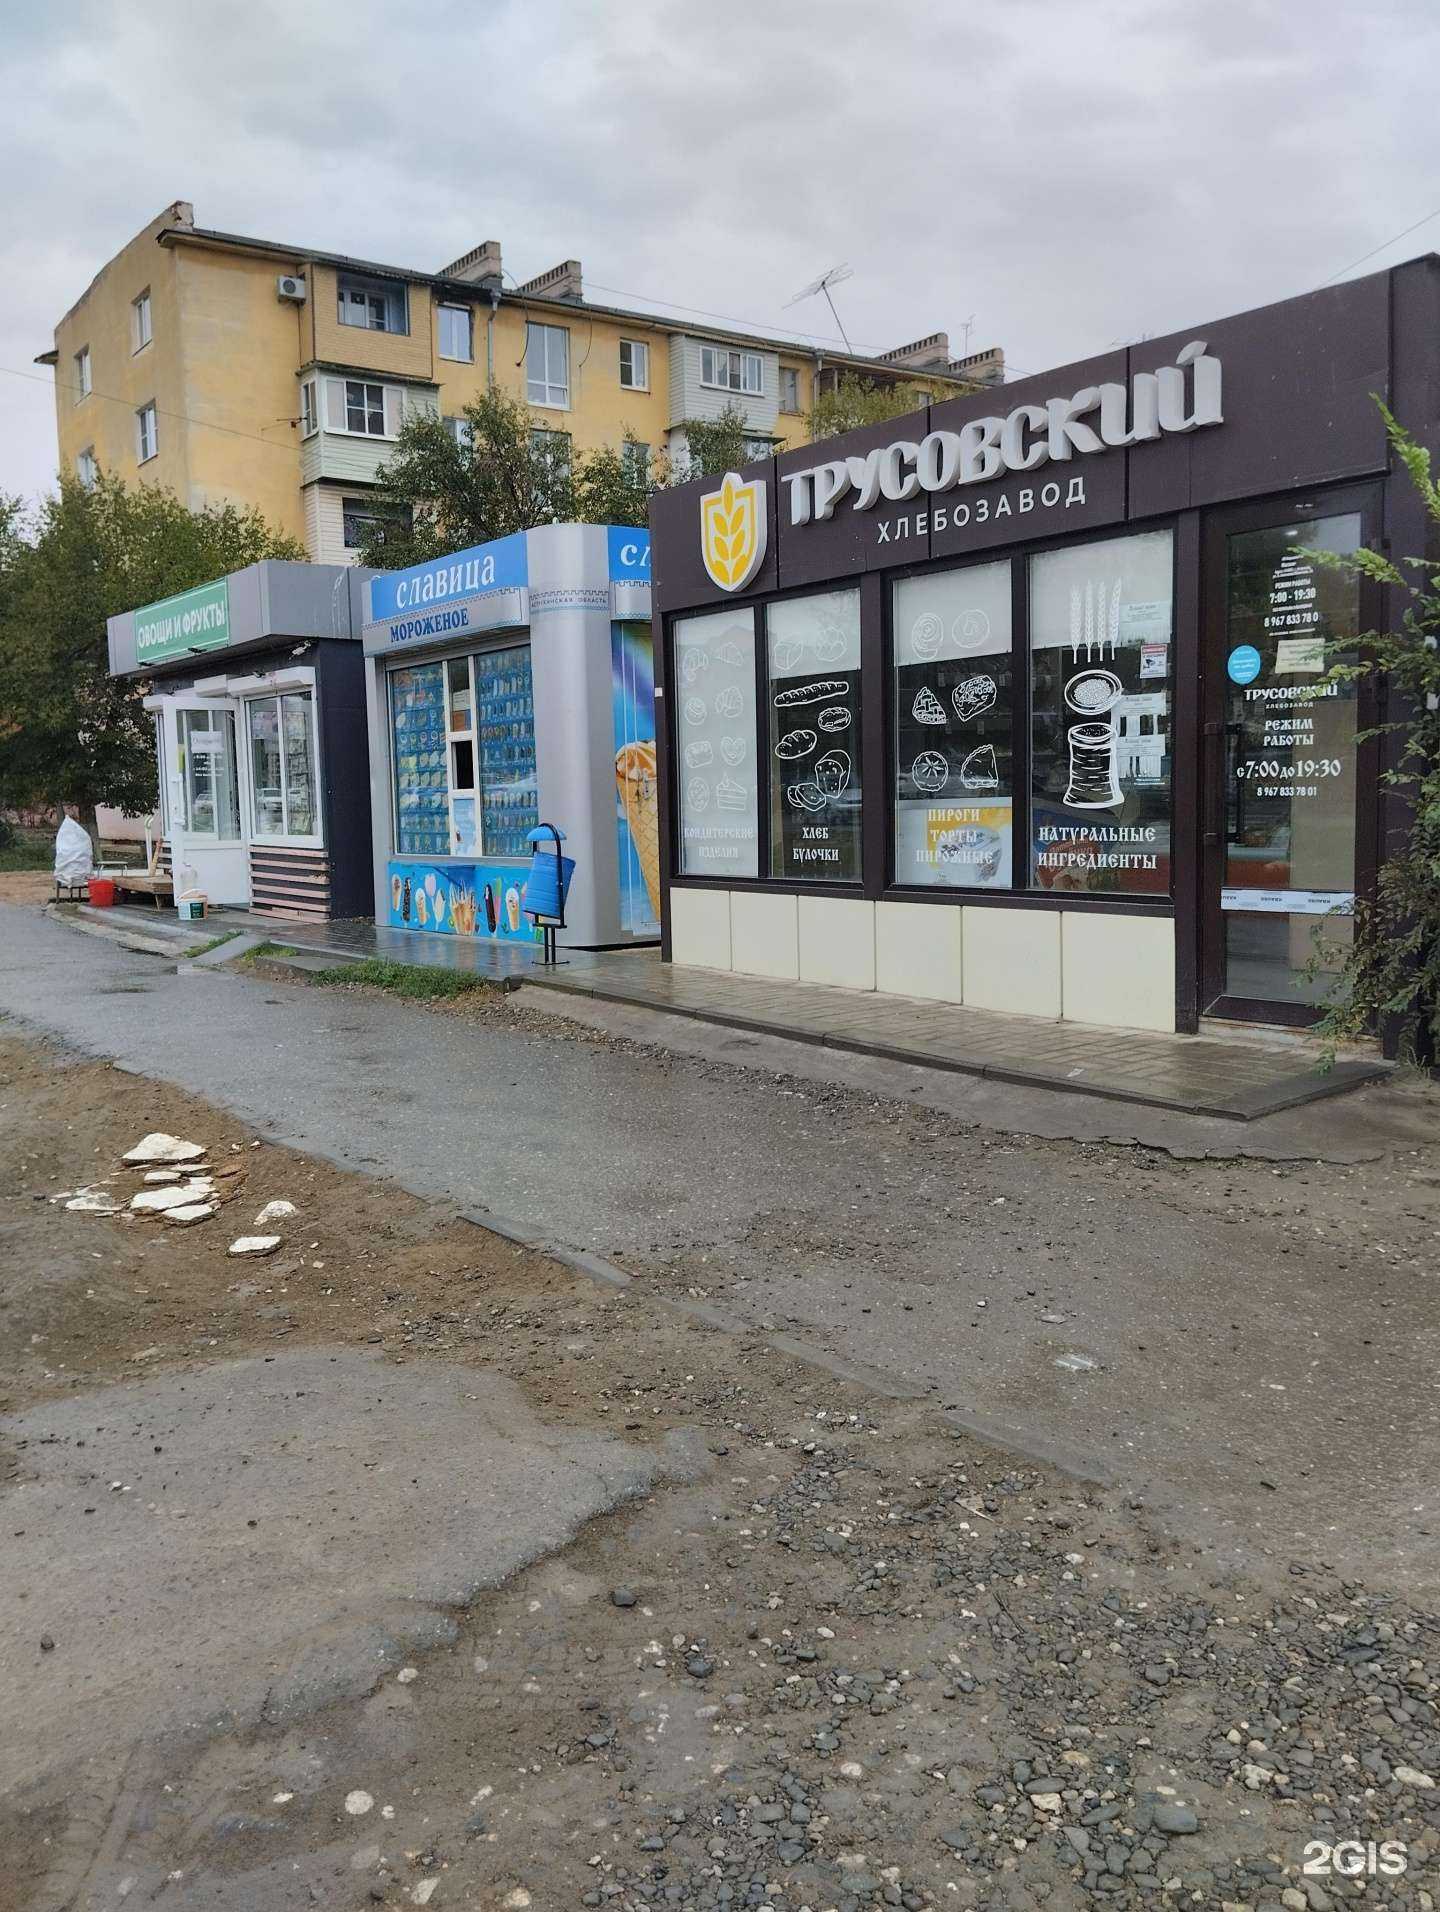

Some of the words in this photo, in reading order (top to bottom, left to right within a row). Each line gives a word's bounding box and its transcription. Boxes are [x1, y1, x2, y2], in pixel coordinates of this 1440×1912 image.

[781, 340, 1223, 526] ТРУСОВСКИЙ
[877, 476, 1087, 544] ХЛЕБОЗАВОД
[1269, 592, 1288, 604] 7:00
[1293, 587, 1316, 601] 19:30
[138, 617, 173, 649] ОВОЩИ
[174, 614, 182, 639] И
[182, 601, 226, 636] ФРУКТЫ
[390, 608, 469, 643] МОРОЖЕНОЕ
[1264, 618, 1270, 627] 8
[1270, 616, 1285, 627] 967
[1286, 615, 1300, 625] 833
[1302, 613, 1311, 622] 78
[1264, 718, 1314, 731] РЕЖИМ
[1263, 734, 1315, 747] РАБОТЫ
[1245, 760, 1280, 779] 7:00
[1280, 766, 1296, 780] до
[1296, 759, 1342, 778] 19:30
[1256, 787, 1263, 796] 8
[1264, 786, 1278, 796] 967
[1280, 786, 1294, 796] 833
[1296, 786, 1306, 796] 78
[1308, 786, 1317, 796] 01
[928, 808, 980, 822] ПИРОГИ
[802, 827, 829, 839] ХЛЕБ
[930, 829, 977, 843] ТОРТЫ
[1039, 827, 1156, 845] НАТУРАЛЬНЫЕ
[792, 847, 840, 863] БУЛОЧКИ
[916, 849, 994, 864] ПИРОЖНЫЕ
[1038, 852, 1158, 870] ИНГРЕДИЕНТЫ
